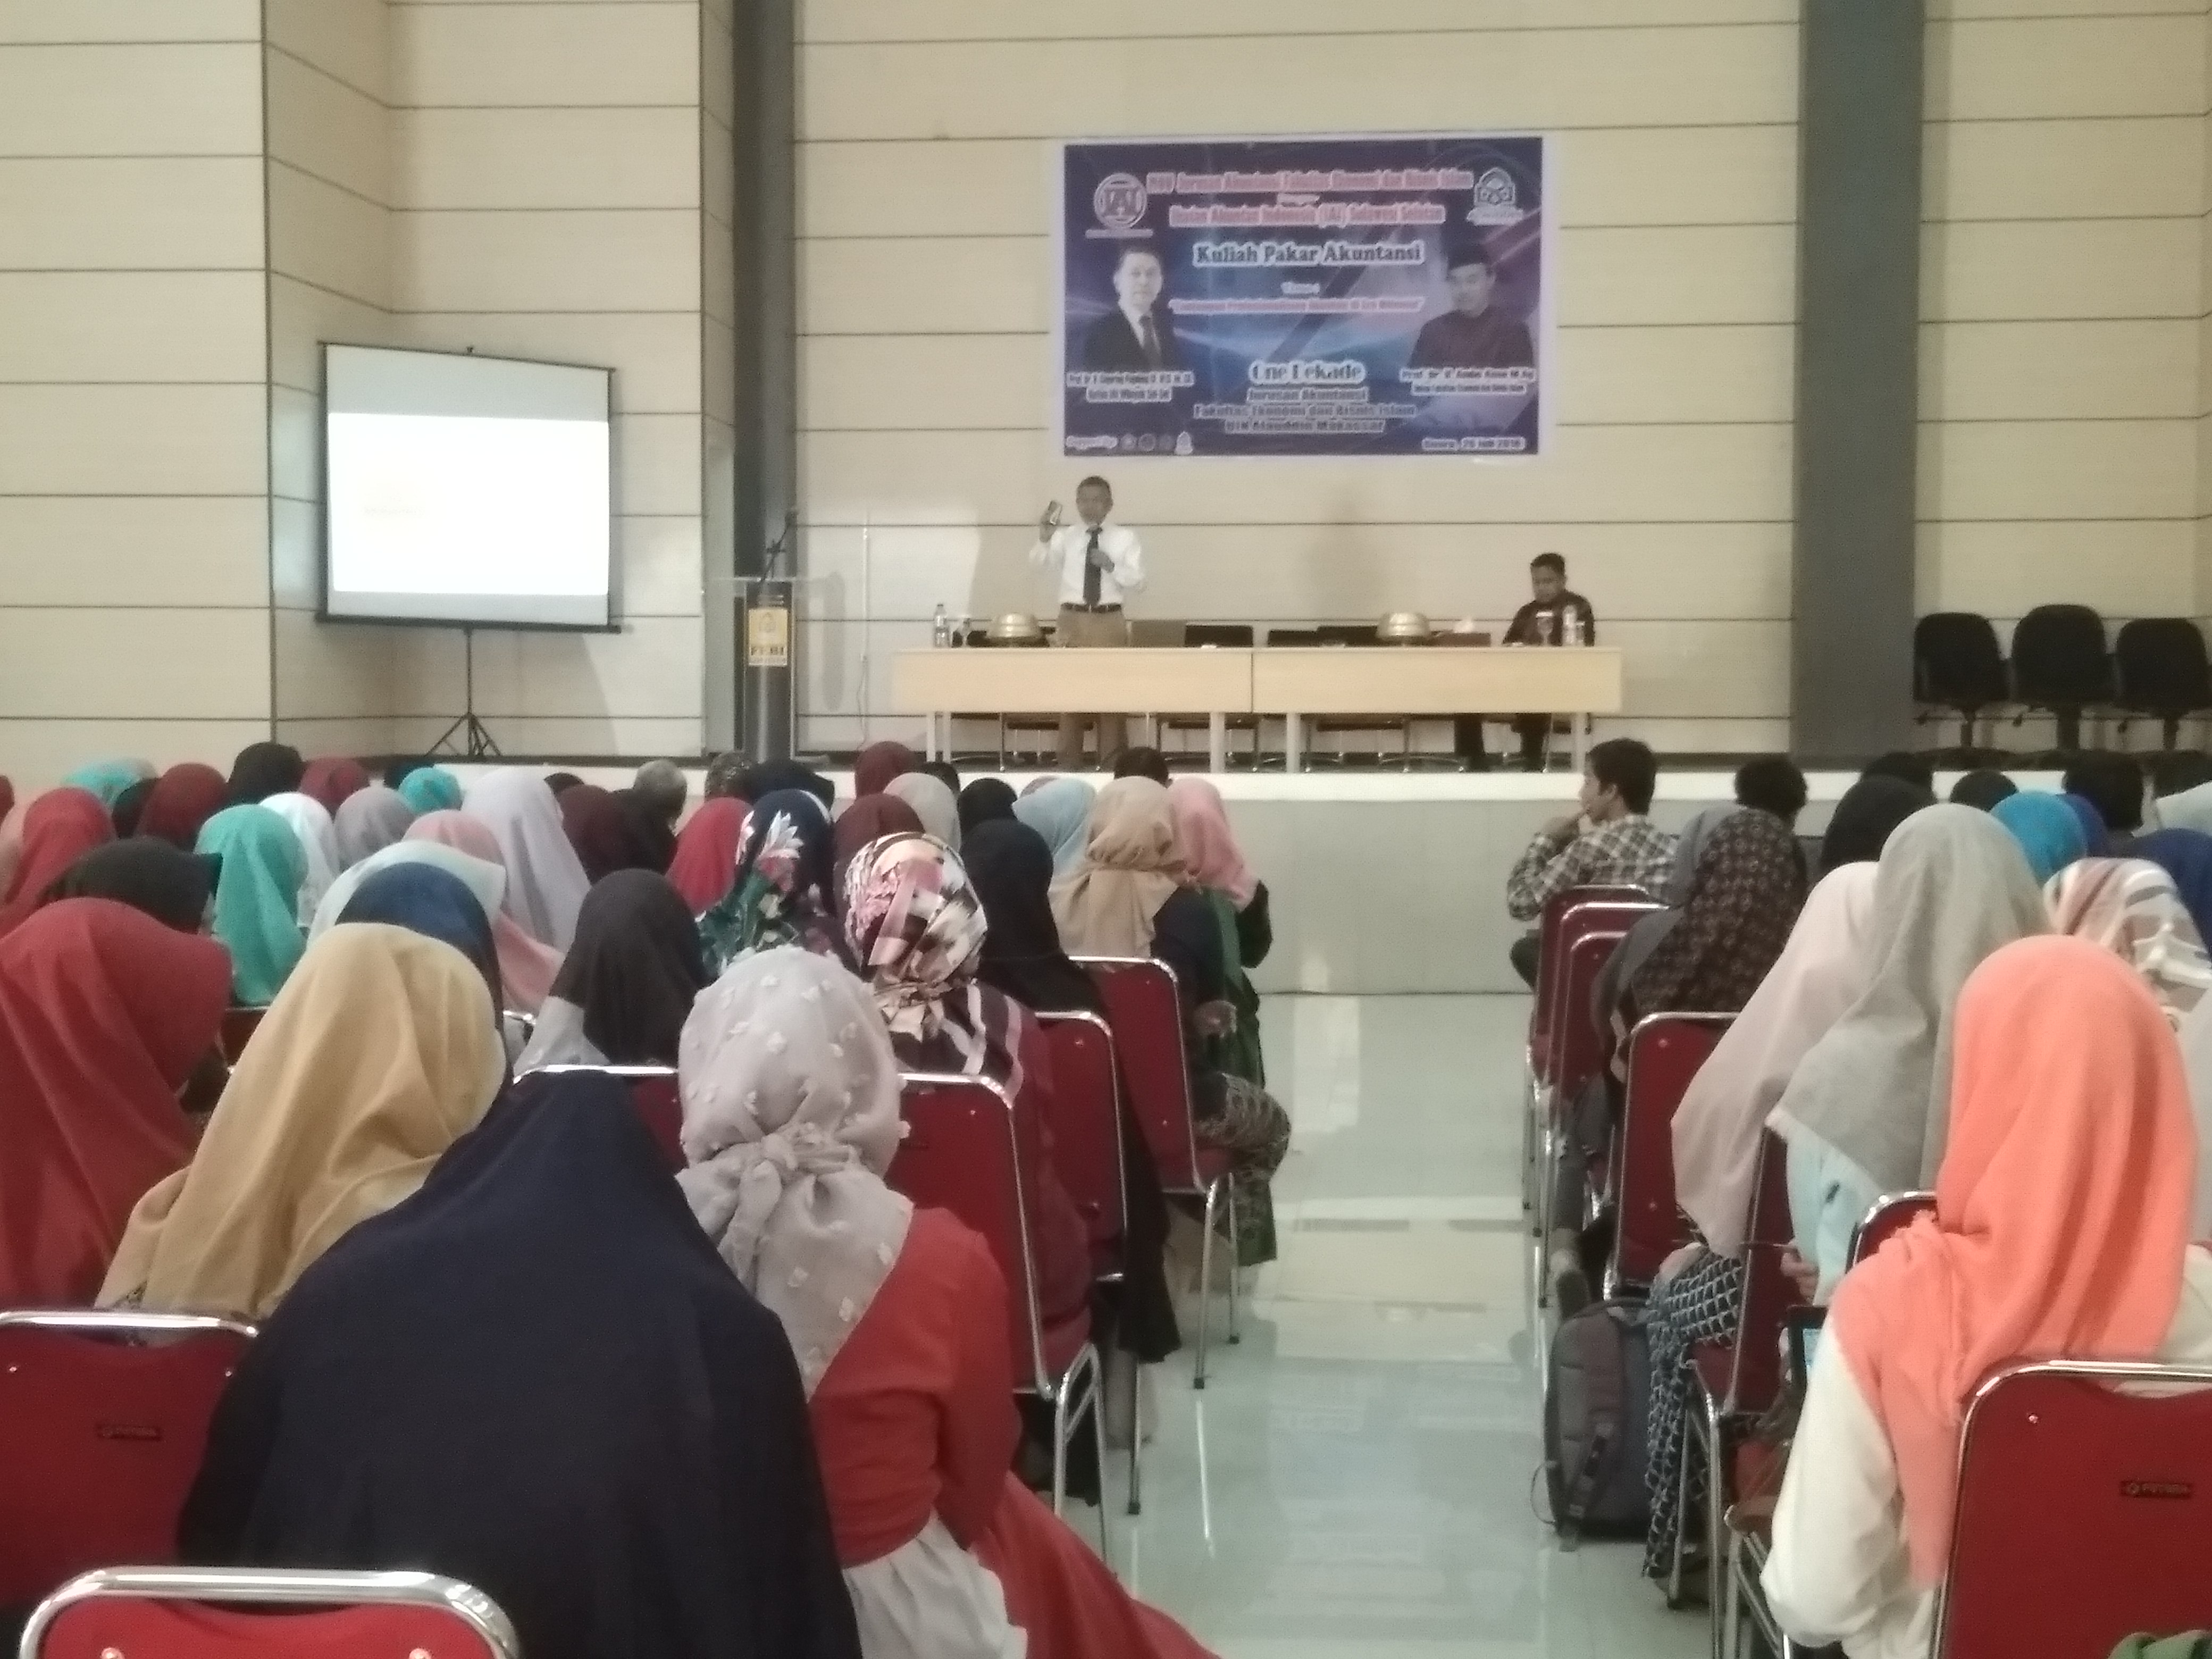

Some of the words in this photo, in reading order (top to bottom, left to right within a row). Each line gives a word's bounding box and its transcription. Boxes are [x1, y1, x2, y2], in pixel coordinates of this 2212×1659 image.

[1196, 245, 1258, 263] Kuliah
[1264, 245, 1319, 262] Pakar
[1323, 244, 1421, 261] Akuntansi
